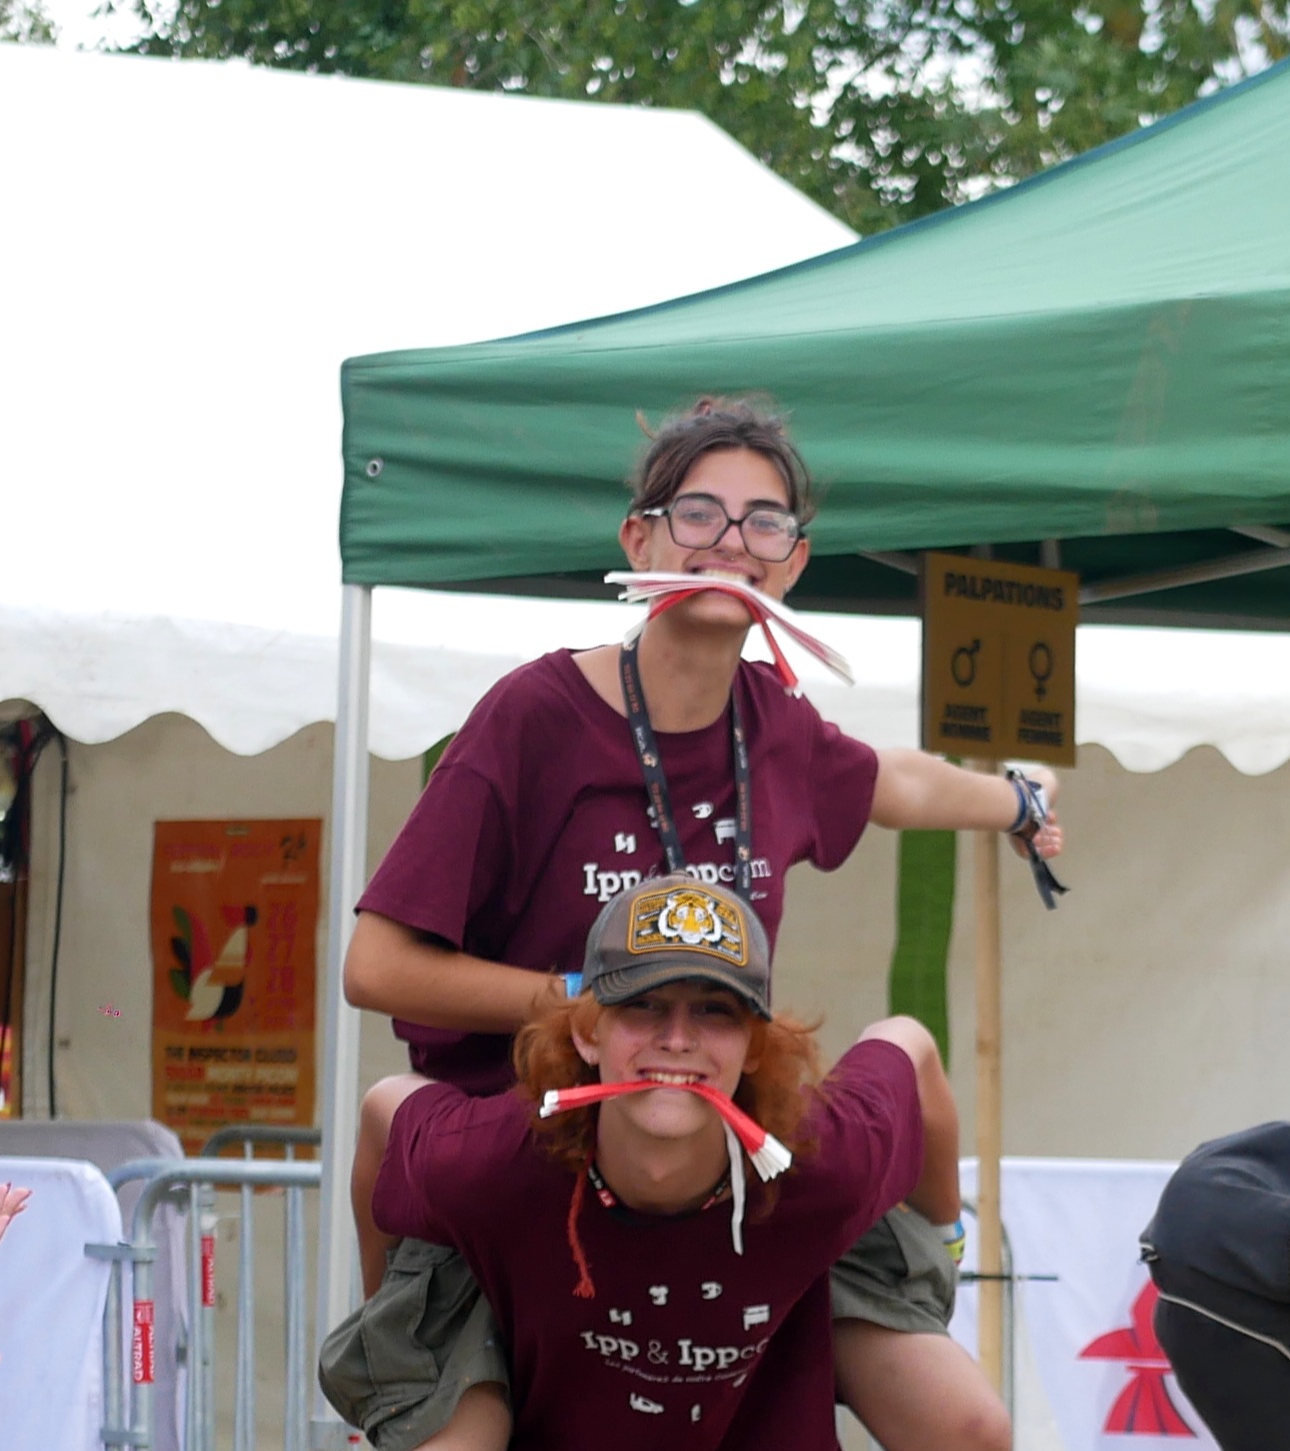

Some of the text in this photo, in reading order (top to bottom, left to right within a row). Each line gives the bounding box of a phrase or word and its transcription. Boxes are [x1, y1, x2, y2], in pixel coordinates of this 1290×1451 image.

[943, 571, 1065, 612] PALPATIONS
[580, 1330, 640, 1361] Ipp
[647, 1338, 670, 1365] &
